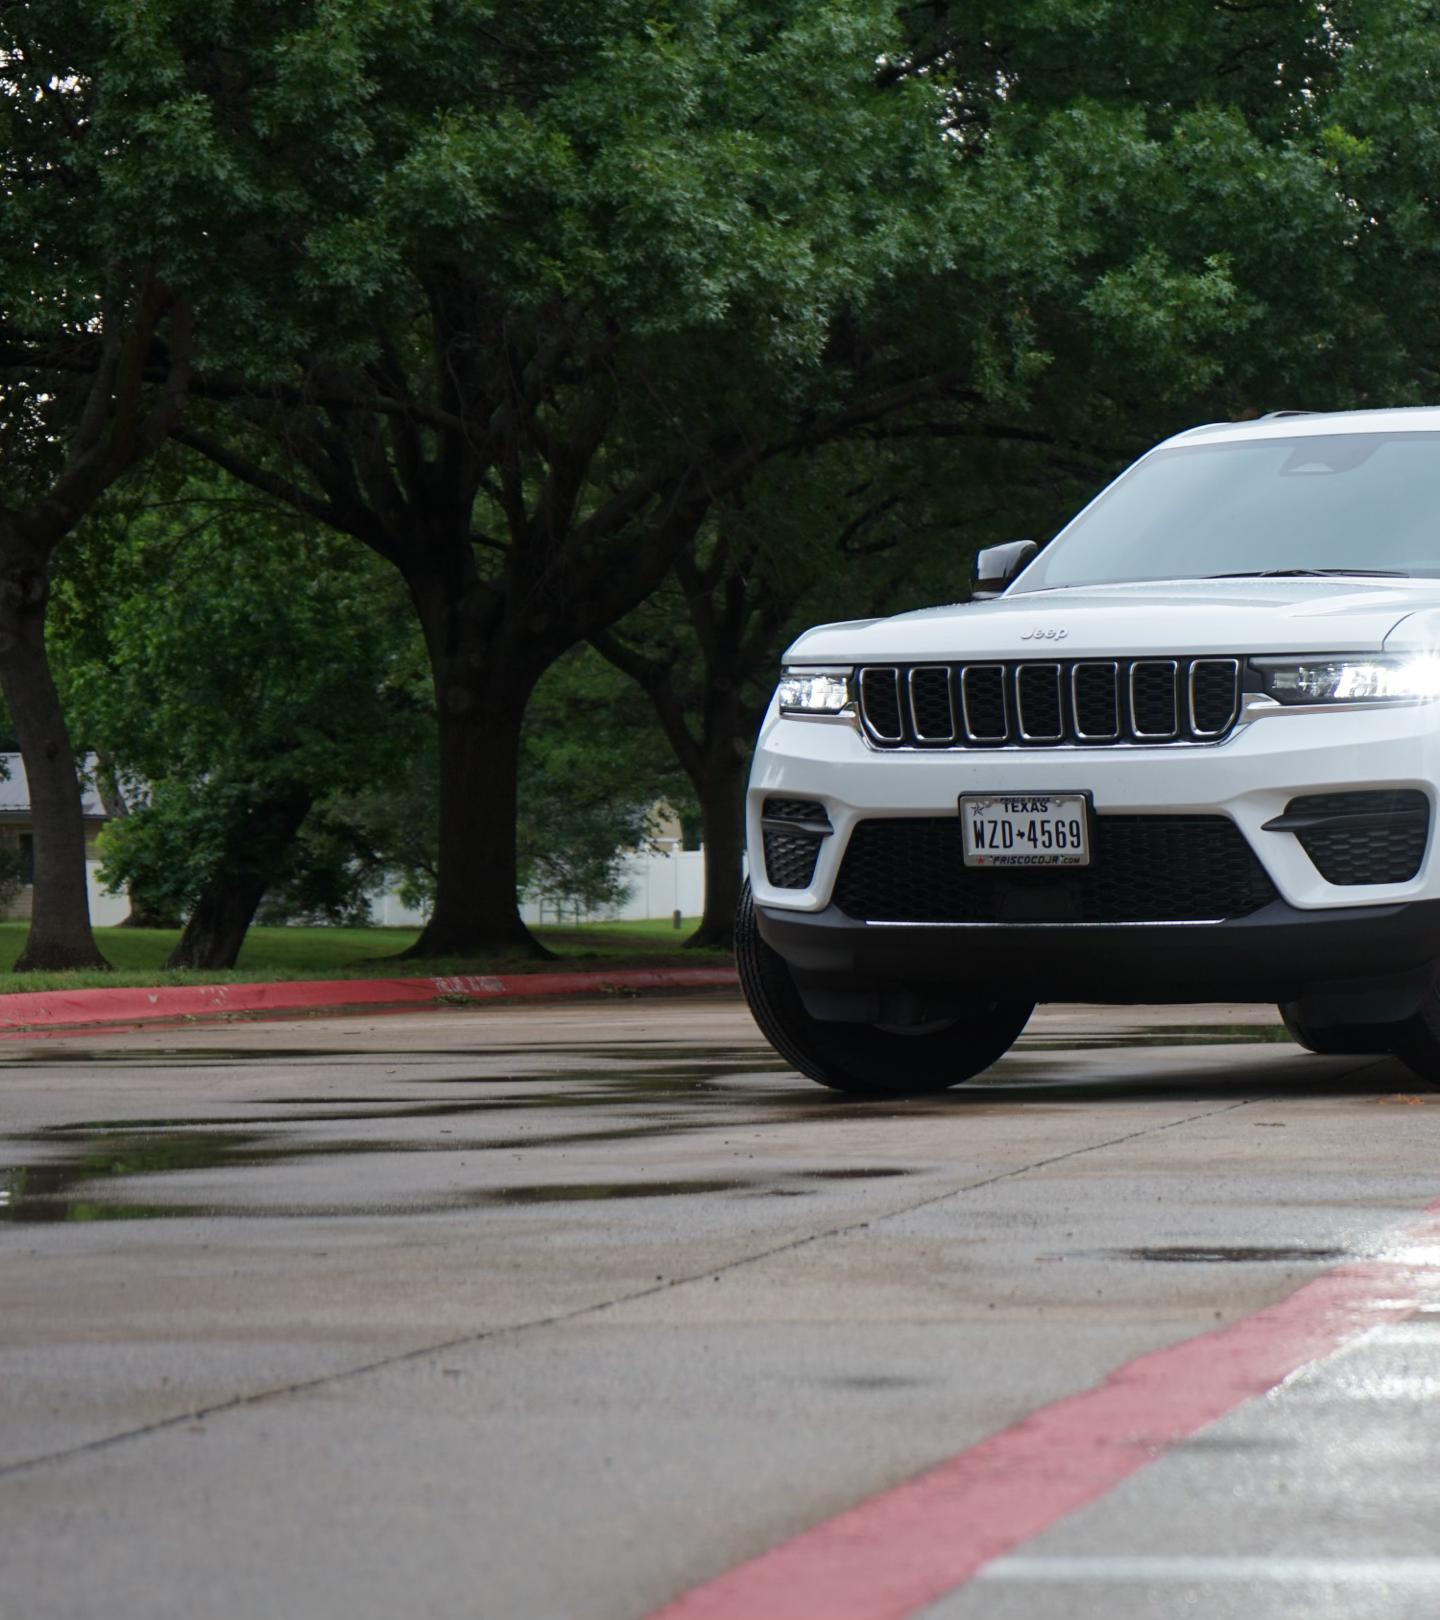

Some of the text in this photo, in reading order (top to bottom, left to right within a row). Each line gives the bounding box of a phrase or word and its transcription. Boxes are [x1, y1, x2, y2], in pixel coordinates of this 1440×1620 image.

[1020, 626, 1068, 641] Jeep
[1004, 801, 1049, 813] TEXAS
[973, 819, 1081, 849] WZD 4569
